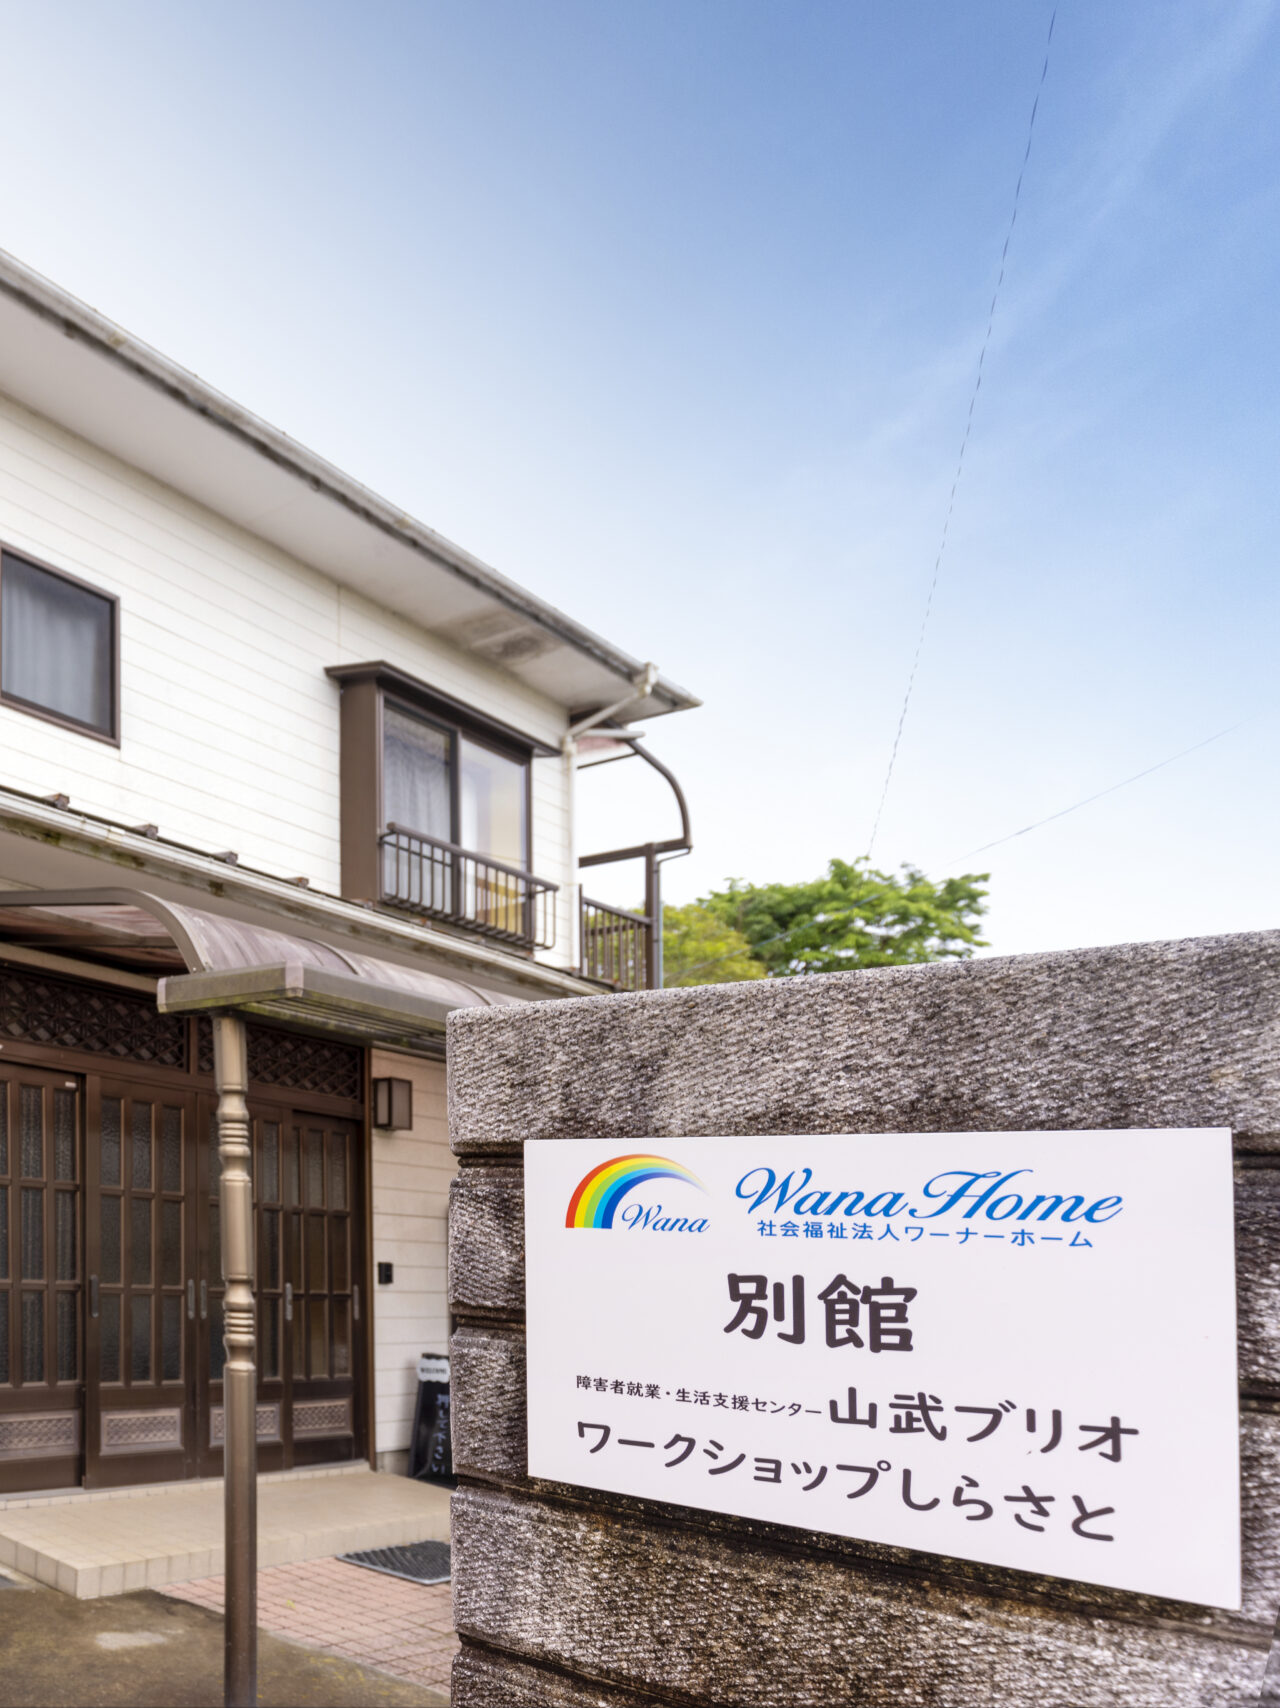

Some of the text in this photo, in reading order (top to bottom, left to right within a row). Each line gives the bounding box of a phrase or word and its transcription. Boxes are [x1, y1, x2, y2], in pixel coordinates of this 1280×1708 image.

[621, 1203, 709, 1233] Wana
[734, 1166, 1124, 1224] Wana Home
[756, 1219, 1094, 1248] 社会福祉法人ワーナーホーム
[723, 1272, 918, 1354] 別館
[828, 1386, 1140, 1463] 山武ブリオ
[577, 1421, 1115, 1542] ワークショップしらさと
